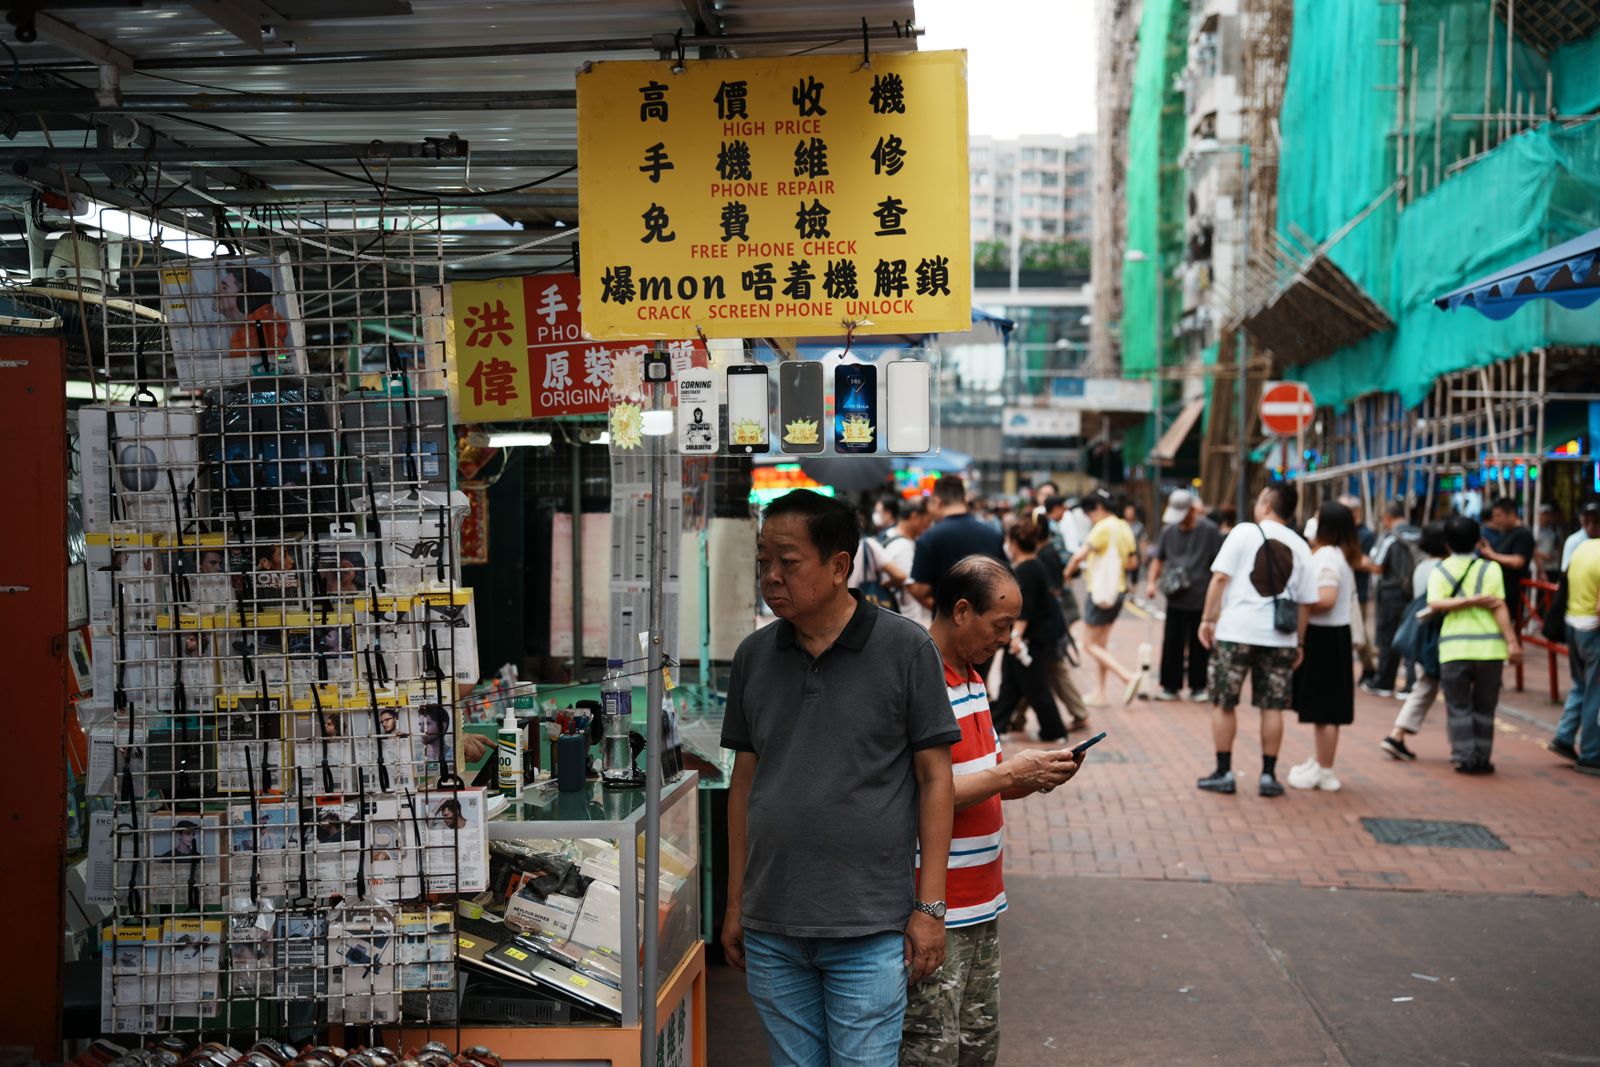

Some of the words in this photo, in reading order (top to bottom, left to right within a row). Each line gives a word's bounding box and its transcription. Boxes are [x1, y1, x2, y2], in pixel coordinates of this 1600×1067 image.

[638, 73, 906, 122] 高價收機
[723, 121, 765, 136] HIGH
[775, 120, 821, 135] PRICE
[639, 134, 907, 184] 手機維修
[711, 182, 768, 198] PHONE
[777, 180, 835, 196] REPAIR
[640, 196, 908, 244] 免費檢查
[691, 244, 729, 259] FREE
[737, 243, 794, 257] PHONE
[803, 241, 857, 256] CHECK
[873, 255, 951, 298] 解鎖
[637, 305, 692, 320] CRACK
[709, 303, 770, 318] SCREEN
[775, 302, 833, 317] PHONE
[846, 300, 914, 316] UNLOCK
[463, 300, 518, 407] 洪偉
[542, 340, 695, 390] 原裝質
[680, 381, 712, 389] CORNING
